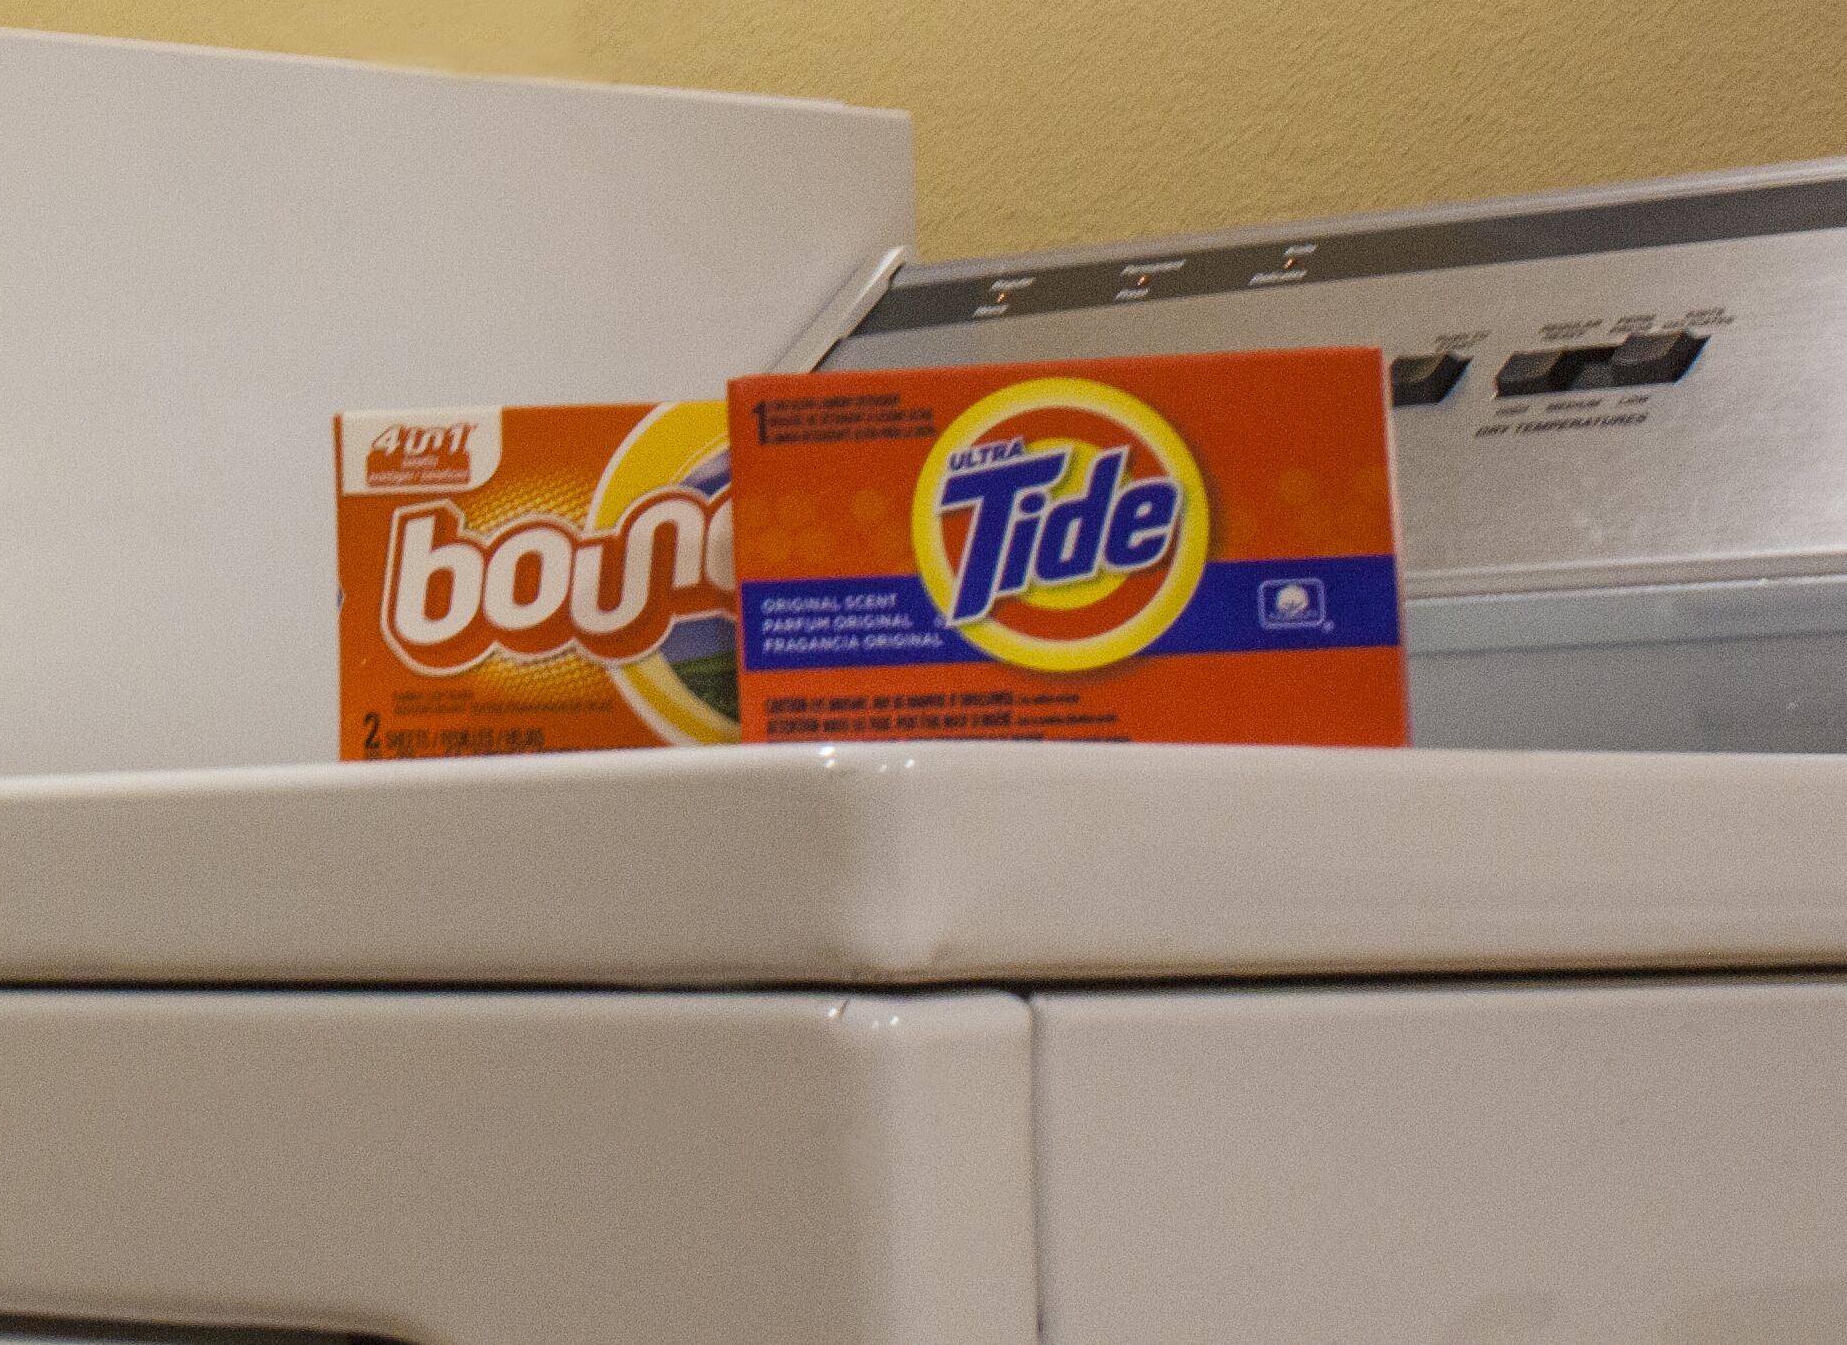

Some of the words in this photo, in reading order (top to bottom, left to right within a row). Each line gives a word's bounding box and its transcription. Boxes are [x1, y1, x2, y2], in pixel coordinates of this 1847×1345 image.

[752, 399, 768, 446] 1
[1514, 411, 1650, 434] TEMPERATURES
[950, 439, 1024, 470] ULTRA
[938, 448, 1180, 625] Tide
[761, 596, 841, 614] ORIGINAL
[844, 593, 898, 611] SCENT
[762, 616, 831, 634] PARFUM
[833, 613, 913, 631] ORIGINAL
[762, 634, 860, 653] FRAGANCIA
[863, 631, 944, 649] ORIGINAL
[363, 711, 382, 750] 2
